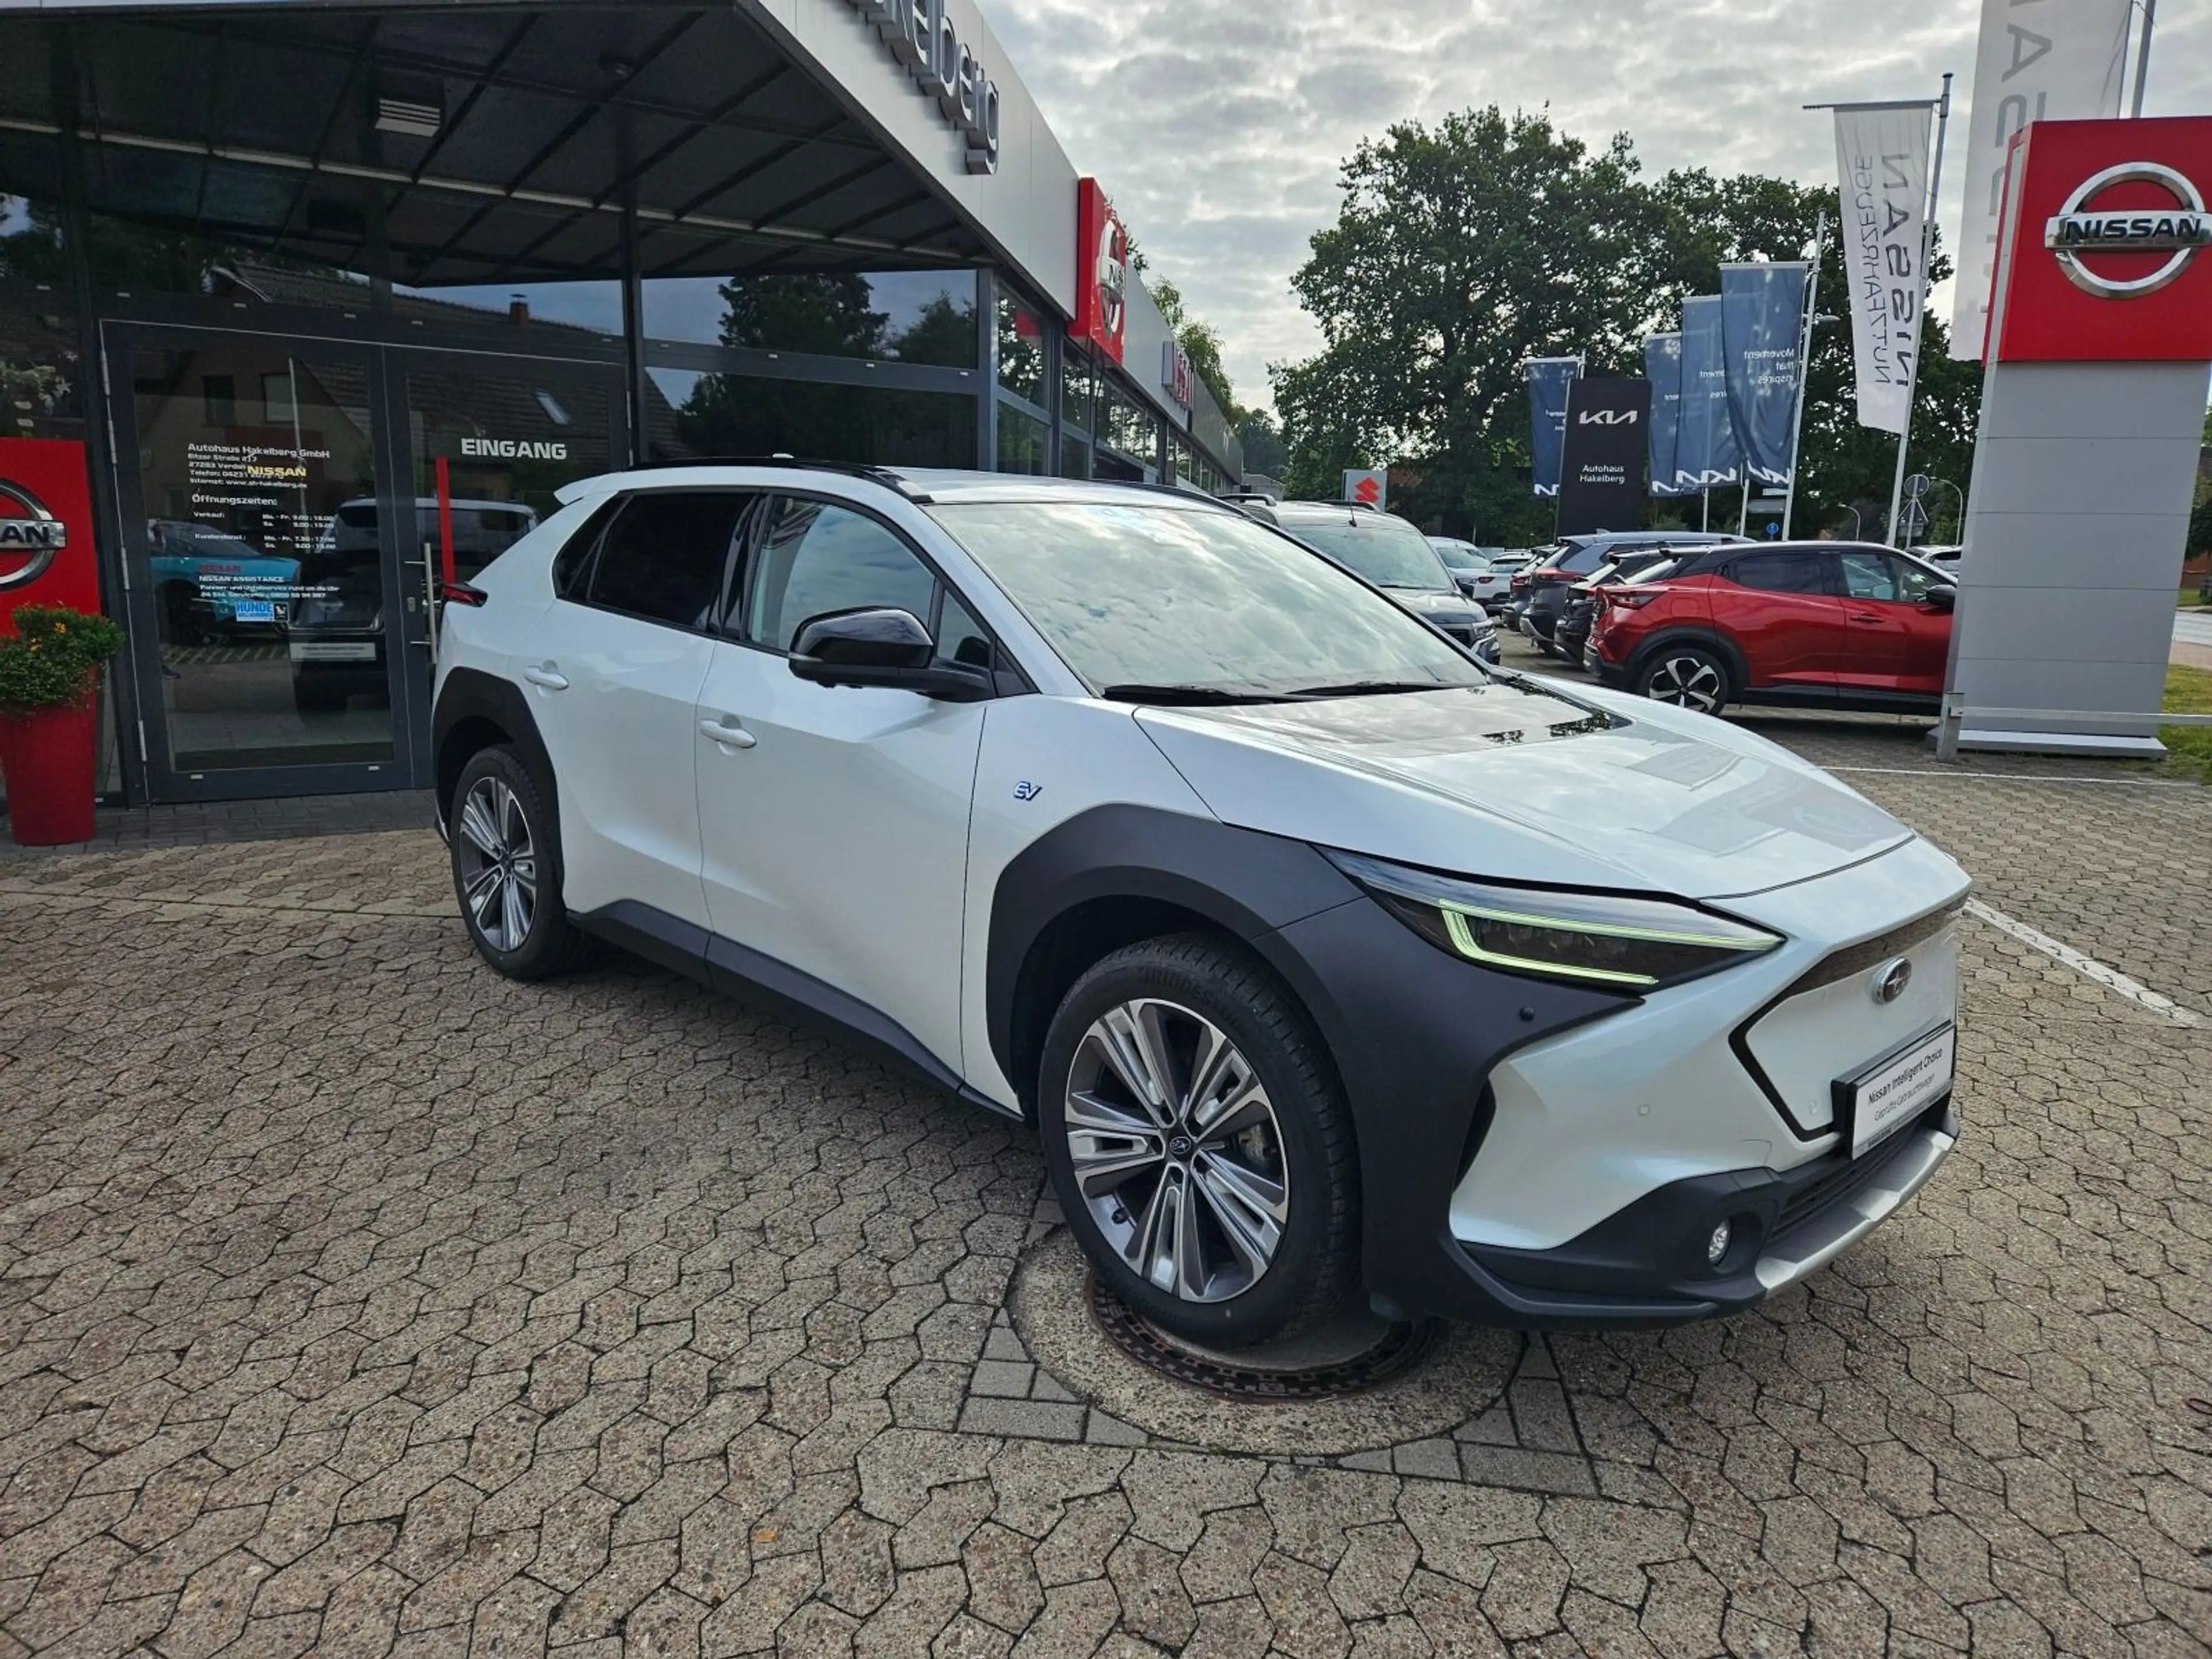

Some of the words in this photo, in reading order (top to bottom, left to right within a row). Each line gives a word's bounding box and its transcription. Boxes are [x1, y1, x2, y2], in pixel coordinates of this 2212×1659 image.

[2066, 218, 2201, 240] NISSAN
[1579, 410, 1638, 424] KIA
[188, 443, 240, 453] Autohaus
[243, 446, 297, 457] Hakelberg
[298, 449, 330, 458] GmbH
[461, 438, 567, 460] EINGANG
[247, 465, 306, 476] NISSAN
[1582, 464, 1624, 472] Autohaus
[1580, 475, 1625, 484] Hakelberg
[192, 493, 277, 506] Öffnungszeiten:
[237, 602, 273, 612] HUNDE
[1869, 1084, 1891, 1104] Nissan
[1892, 1059, 1923, 1090] Intelligent
[1923, 1047, 1943, 1067] Choice
